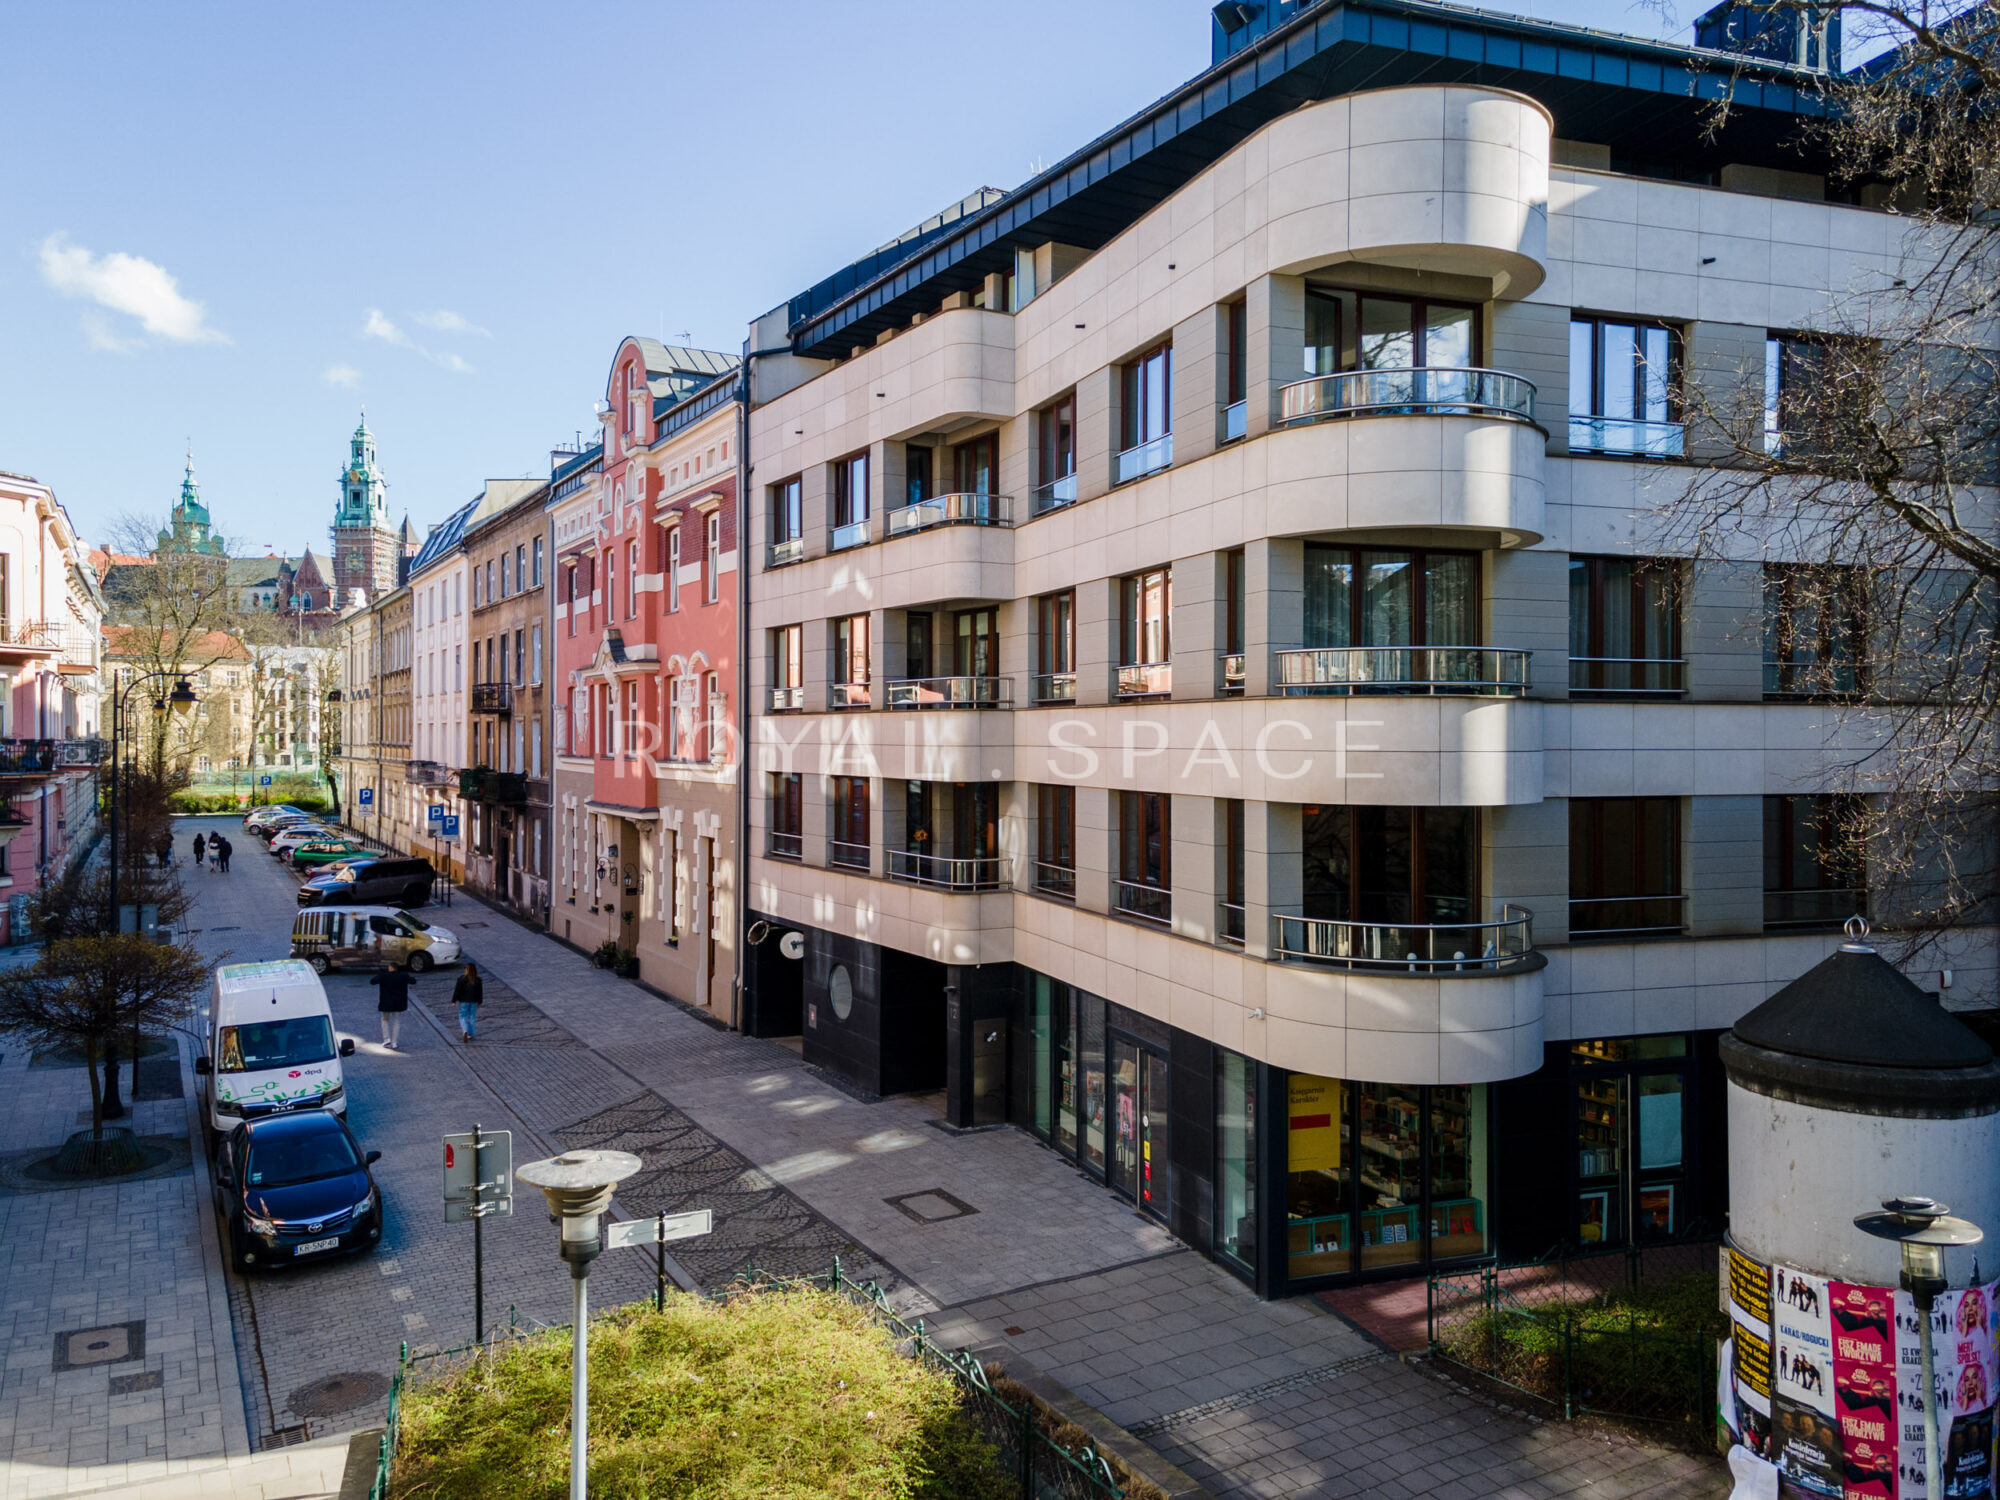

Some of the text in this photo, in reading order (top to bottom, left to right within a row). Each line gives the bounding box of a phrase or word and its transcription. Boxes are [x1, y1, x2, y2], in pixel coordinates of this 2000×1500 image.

[362, 790, 371, 800] P
[432, 807, 442, 819] P
[446, 816, 456, 829] P
[304, 1068, 322, 1076] dpd
[271, 1105, 295, 1113] MAN
